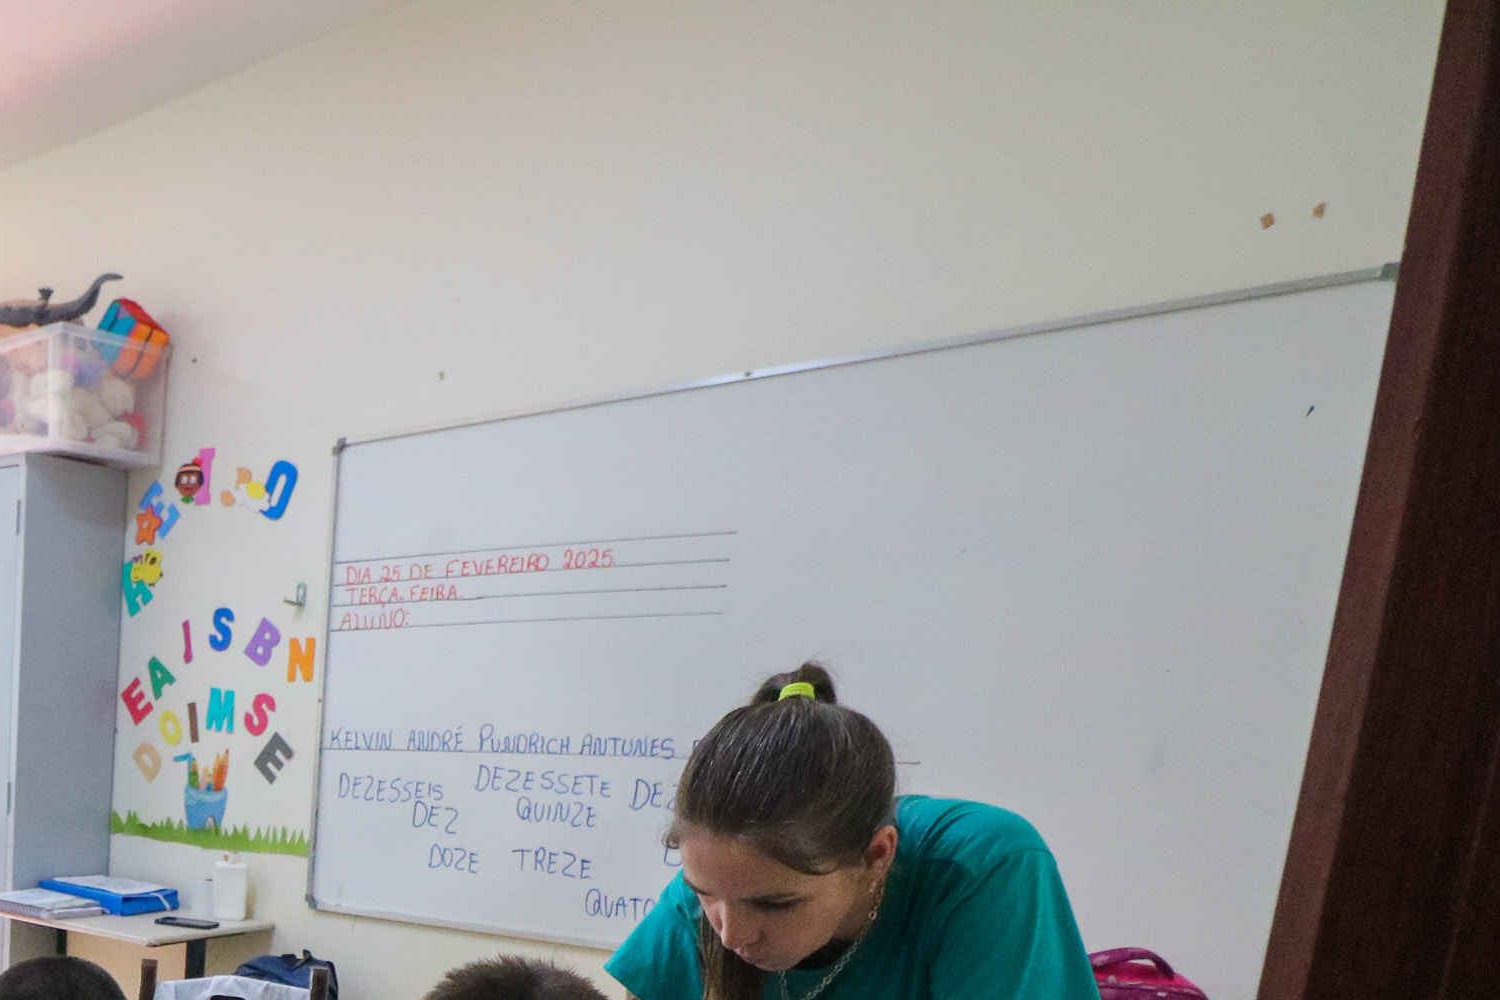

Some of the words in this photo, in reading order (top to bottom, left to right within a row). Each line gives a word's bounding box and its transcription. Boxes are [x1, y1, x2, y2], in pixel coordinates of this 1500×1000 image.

[346, 565, 371, 585] DIA
[380, 565, 400, 583] 25
[409, 563, 434, 581] DE
[445, 553, 549, 578] FEVEREIRO
[329, 726, 392, 750] KELVIN
[406, 725, 463, 752] ANDRÉ
[579, 733, 675, 760] ANTUNES
[338, 772, 444, 803] DEZESSEIS
[474, 764, 612, 798] DEZESSETE
[412, 800, 459, 835] DEZ
[516, 796, 598, 828] QUINZE
[428, 843, 479, 874] DOZE
[511, 846, 592, 880] TREZE
